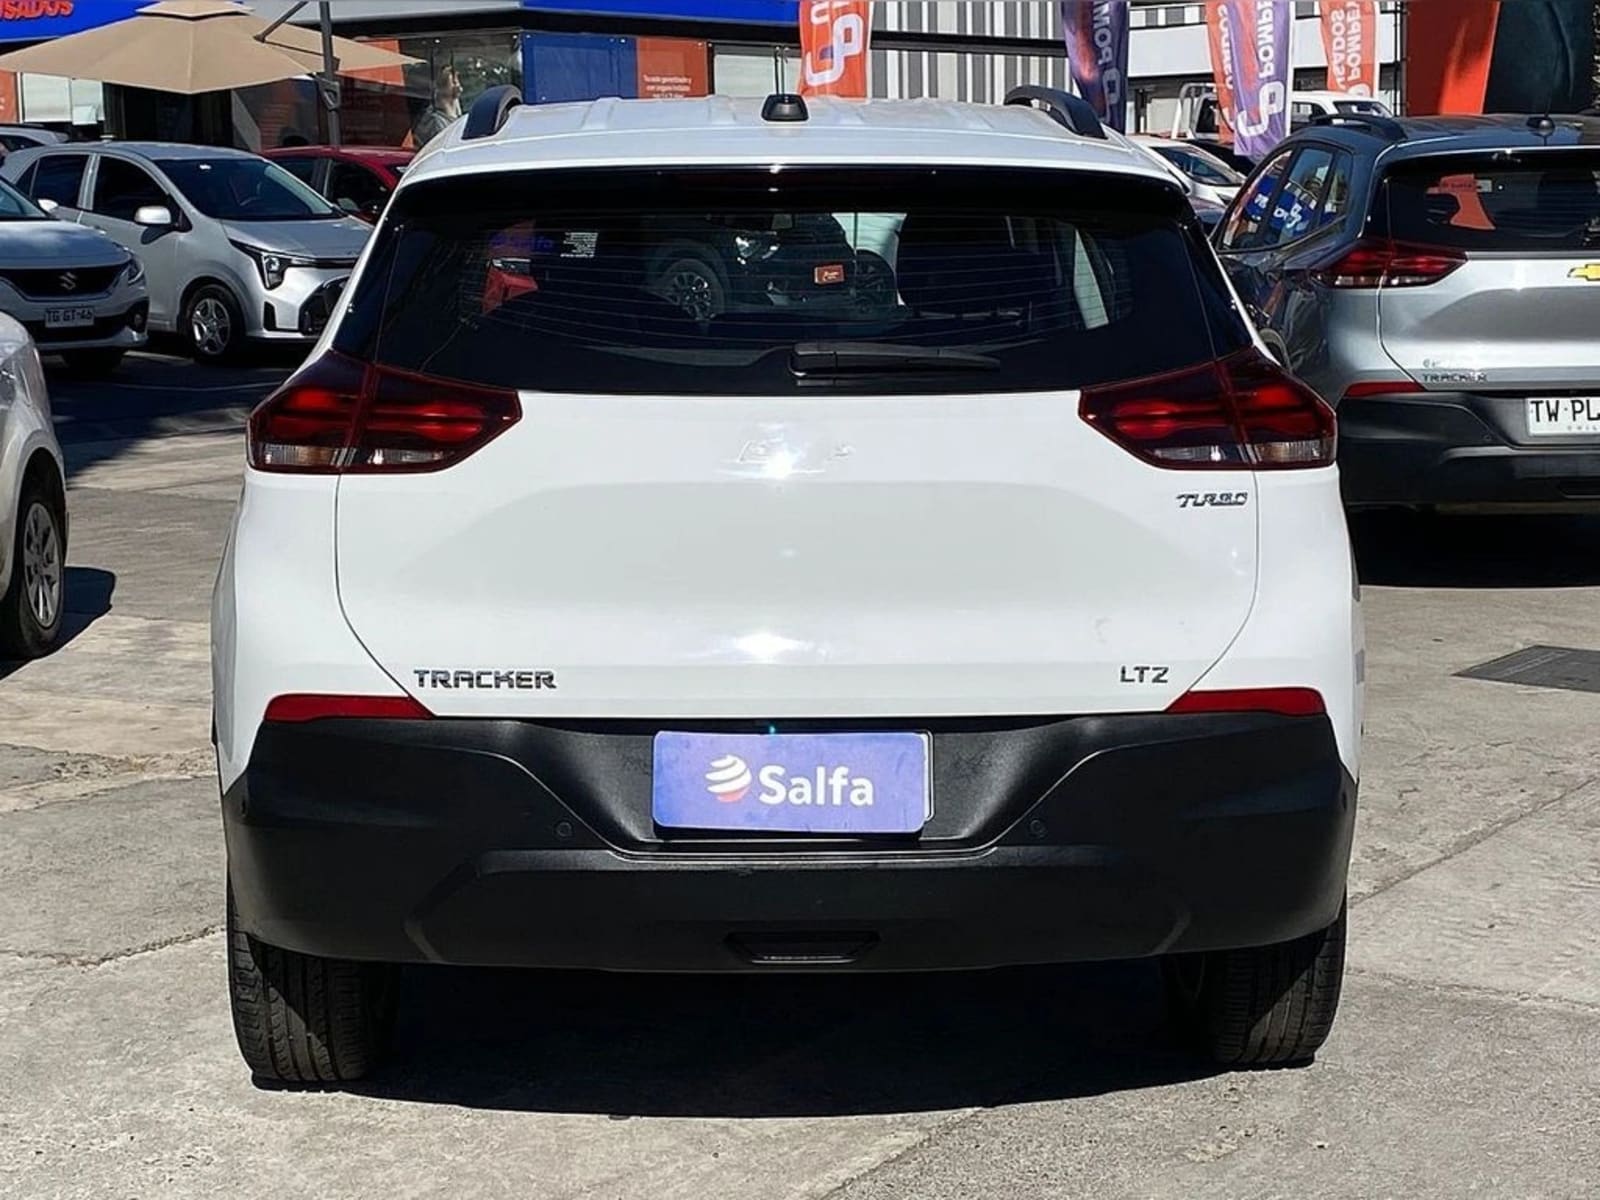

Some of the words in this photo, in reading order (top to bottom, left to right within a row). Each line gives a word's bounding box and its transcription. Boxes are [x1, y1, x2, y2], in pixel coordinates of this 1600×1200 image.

[1175, 492, 1249, 508] TURBO
[413, 669, 557, 689] TRACKER
[1120, 666, 1169, 683] LTZ
[758, 764, 874, 806] Salfa
